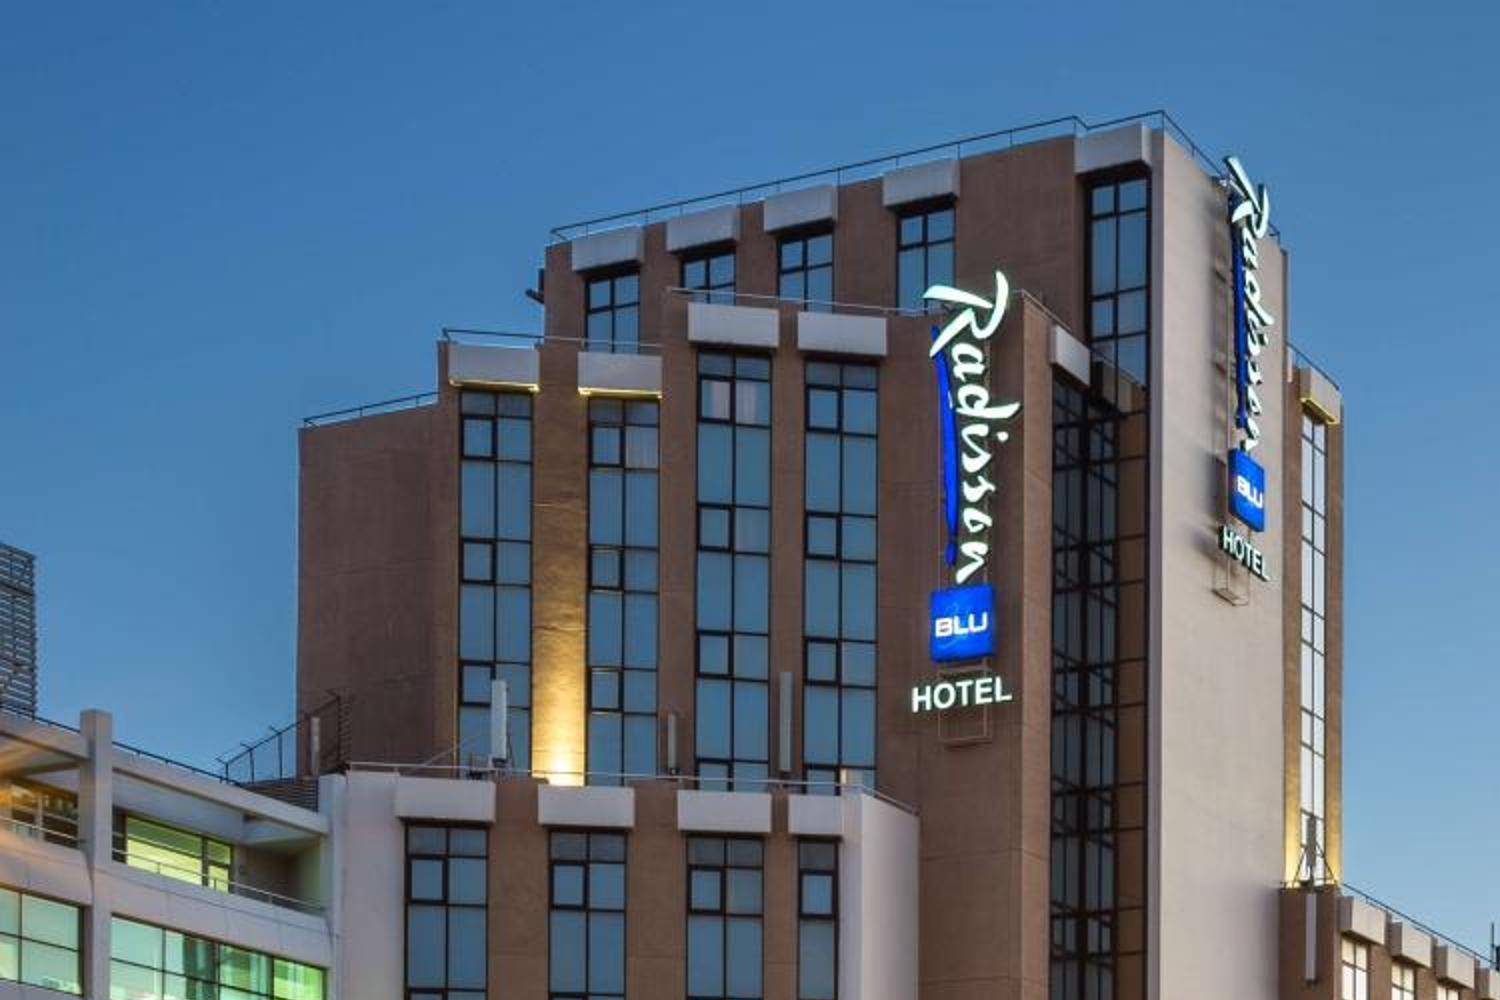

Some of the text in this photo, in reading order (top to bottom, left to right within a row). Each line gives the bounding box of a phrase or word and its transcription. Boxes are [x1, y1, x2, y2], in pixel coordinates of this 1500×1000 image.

[1225, 155, 1275, 450] Radisson
[922, 270, 1020, 585] Radisson
[1237, 474, 1263, 509] BLU
[1222, 525, 1271, 581] HOTEL
[935, 611, 988, 638] BLU
[911, 676, 1013, 713] HOTEL
